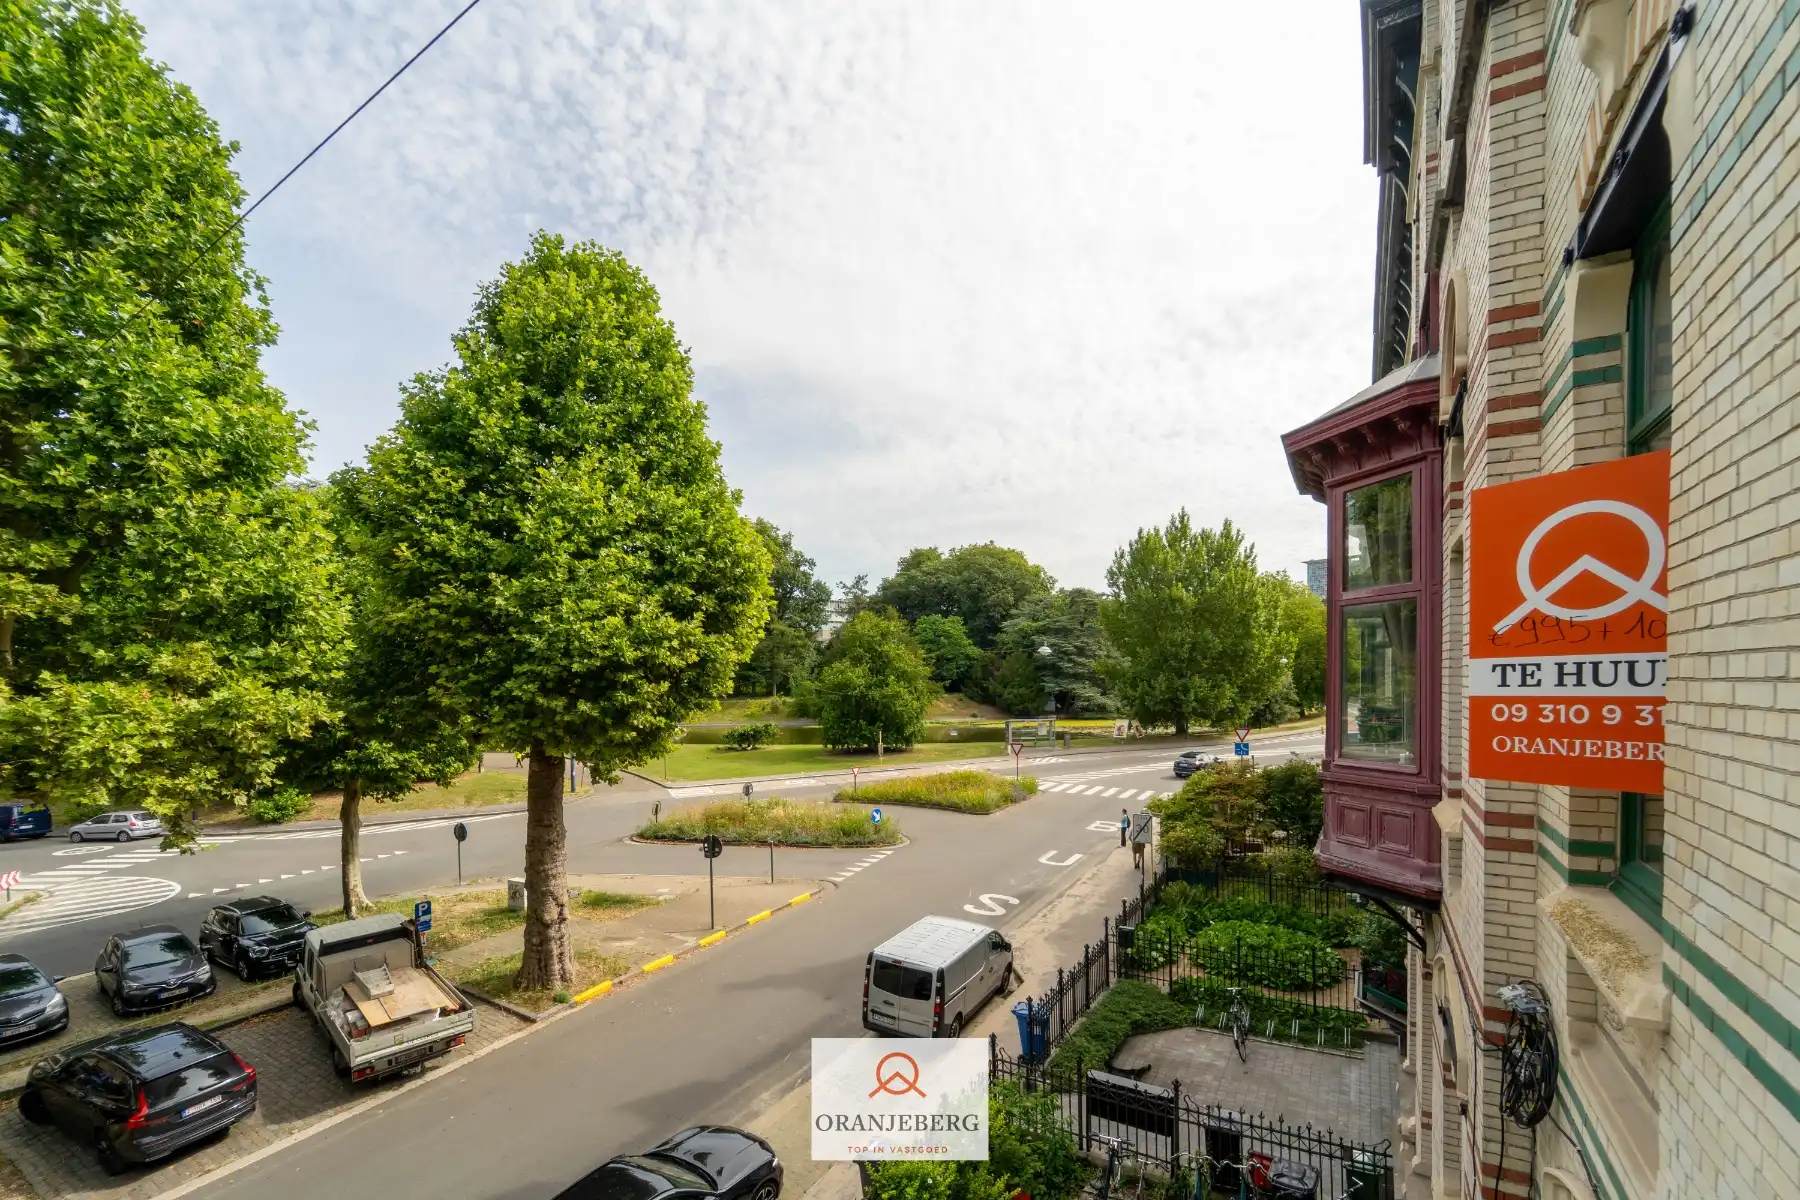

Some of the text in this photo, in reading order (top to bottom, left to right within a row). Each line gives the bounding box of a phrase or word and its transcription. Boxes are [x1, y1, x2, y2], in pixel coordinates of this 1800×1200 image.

[1492, 659, 1667, 688] TE HUU
[1491, 703, 1528, 723] 09
[1538, 704, 1590, 725] 310
[1602, 704, 1622, 725] 9
[418, 903, 428, 917] P
